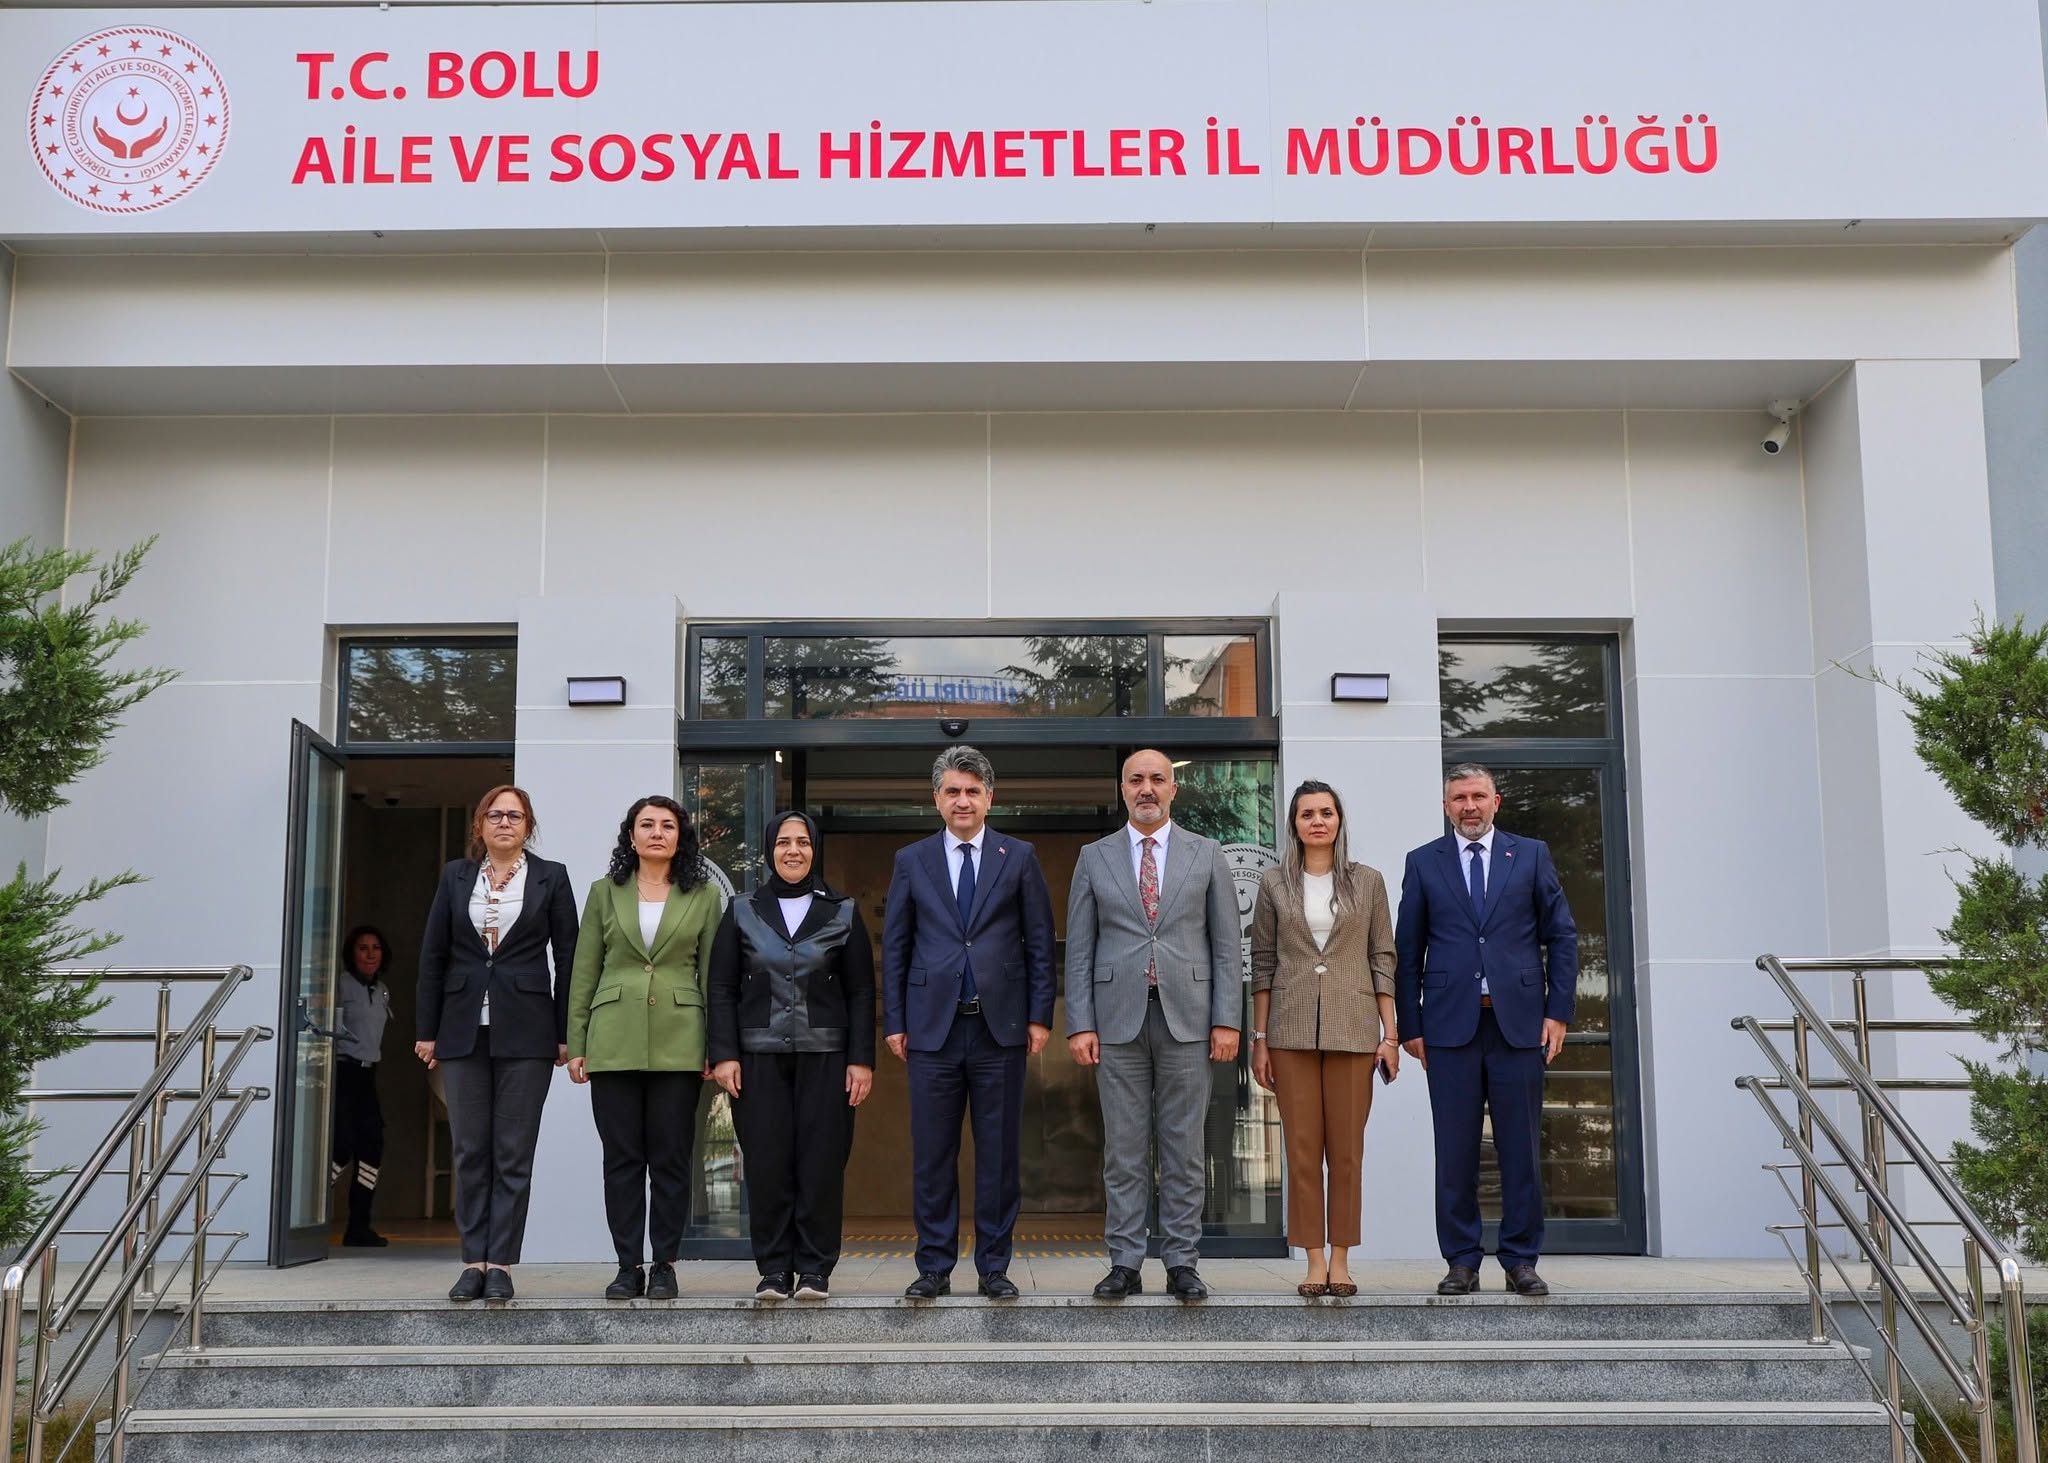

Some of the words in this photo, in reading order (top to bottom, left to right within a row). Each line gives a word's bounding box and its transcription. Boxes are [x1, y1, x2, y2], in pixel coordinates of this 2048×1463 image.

[95, 64, 118, 82] AİLE
[119, 62, 134, 71] VE
[136, 62, 174, 83] SOSYAL
[296, 51, 406, 100] T.C.
[427, 50, 599, 99] BOLU
[67, 77, 96, 146] CUMHURİYETİ
[172, 80, 194, 136] HİZMETLER
[74, 146, 111, 178] TÜRKİYE
[140, 137, 189, 178] BAKANLIĞI
[291, 124, 433, 184] AİLE
[449, 134, 529, 182] VE
[549, 132, 799, 182] SOSYAL
[819, 120, 1186, 179] HİZMETLER
[1206, 116, 1260, 175] İL
[1286, 114, 1718, 176] MÜDÜRLÜĞÜ
[1242, 871, 1262, 881] SOSY
